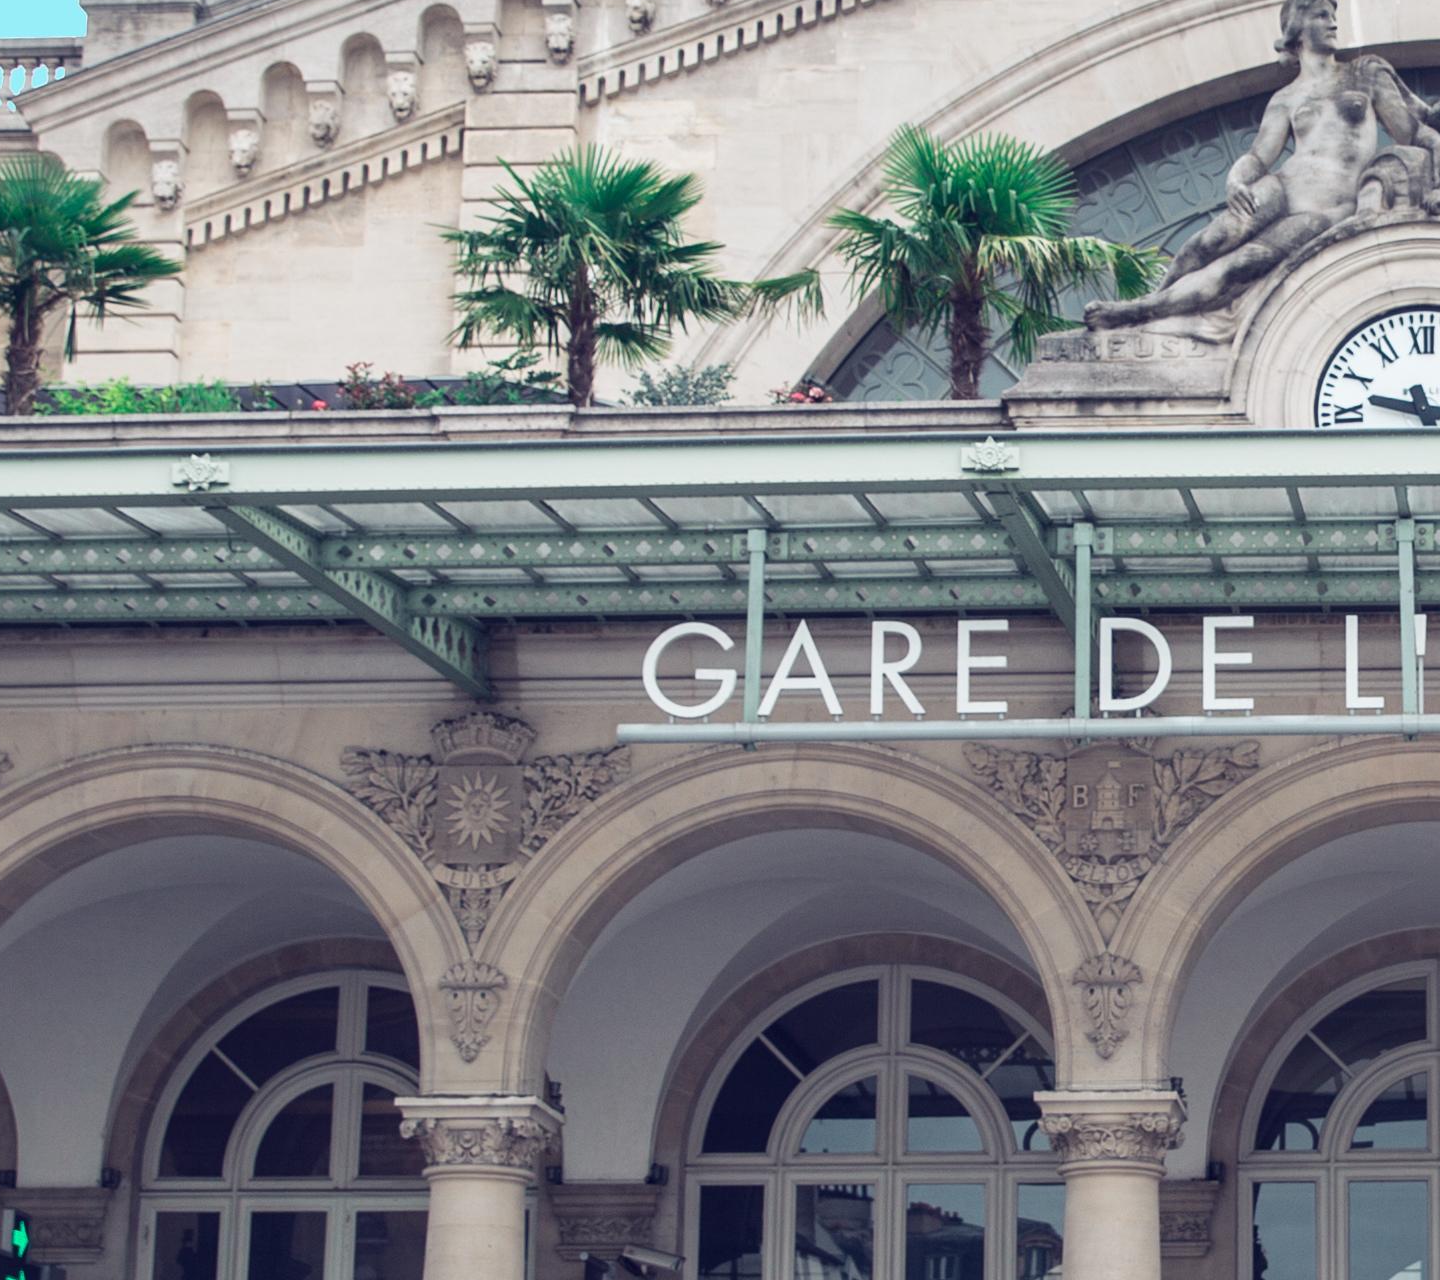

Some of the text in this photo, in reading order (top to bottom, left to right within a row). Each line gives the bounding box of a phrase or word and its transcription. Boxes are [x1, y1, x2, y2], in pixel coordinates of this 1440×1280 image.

[1408, 326, 1435, 355] XII
[642, 619, 1009, 718] GARE
[1099, 616, 1254, 711] DE
